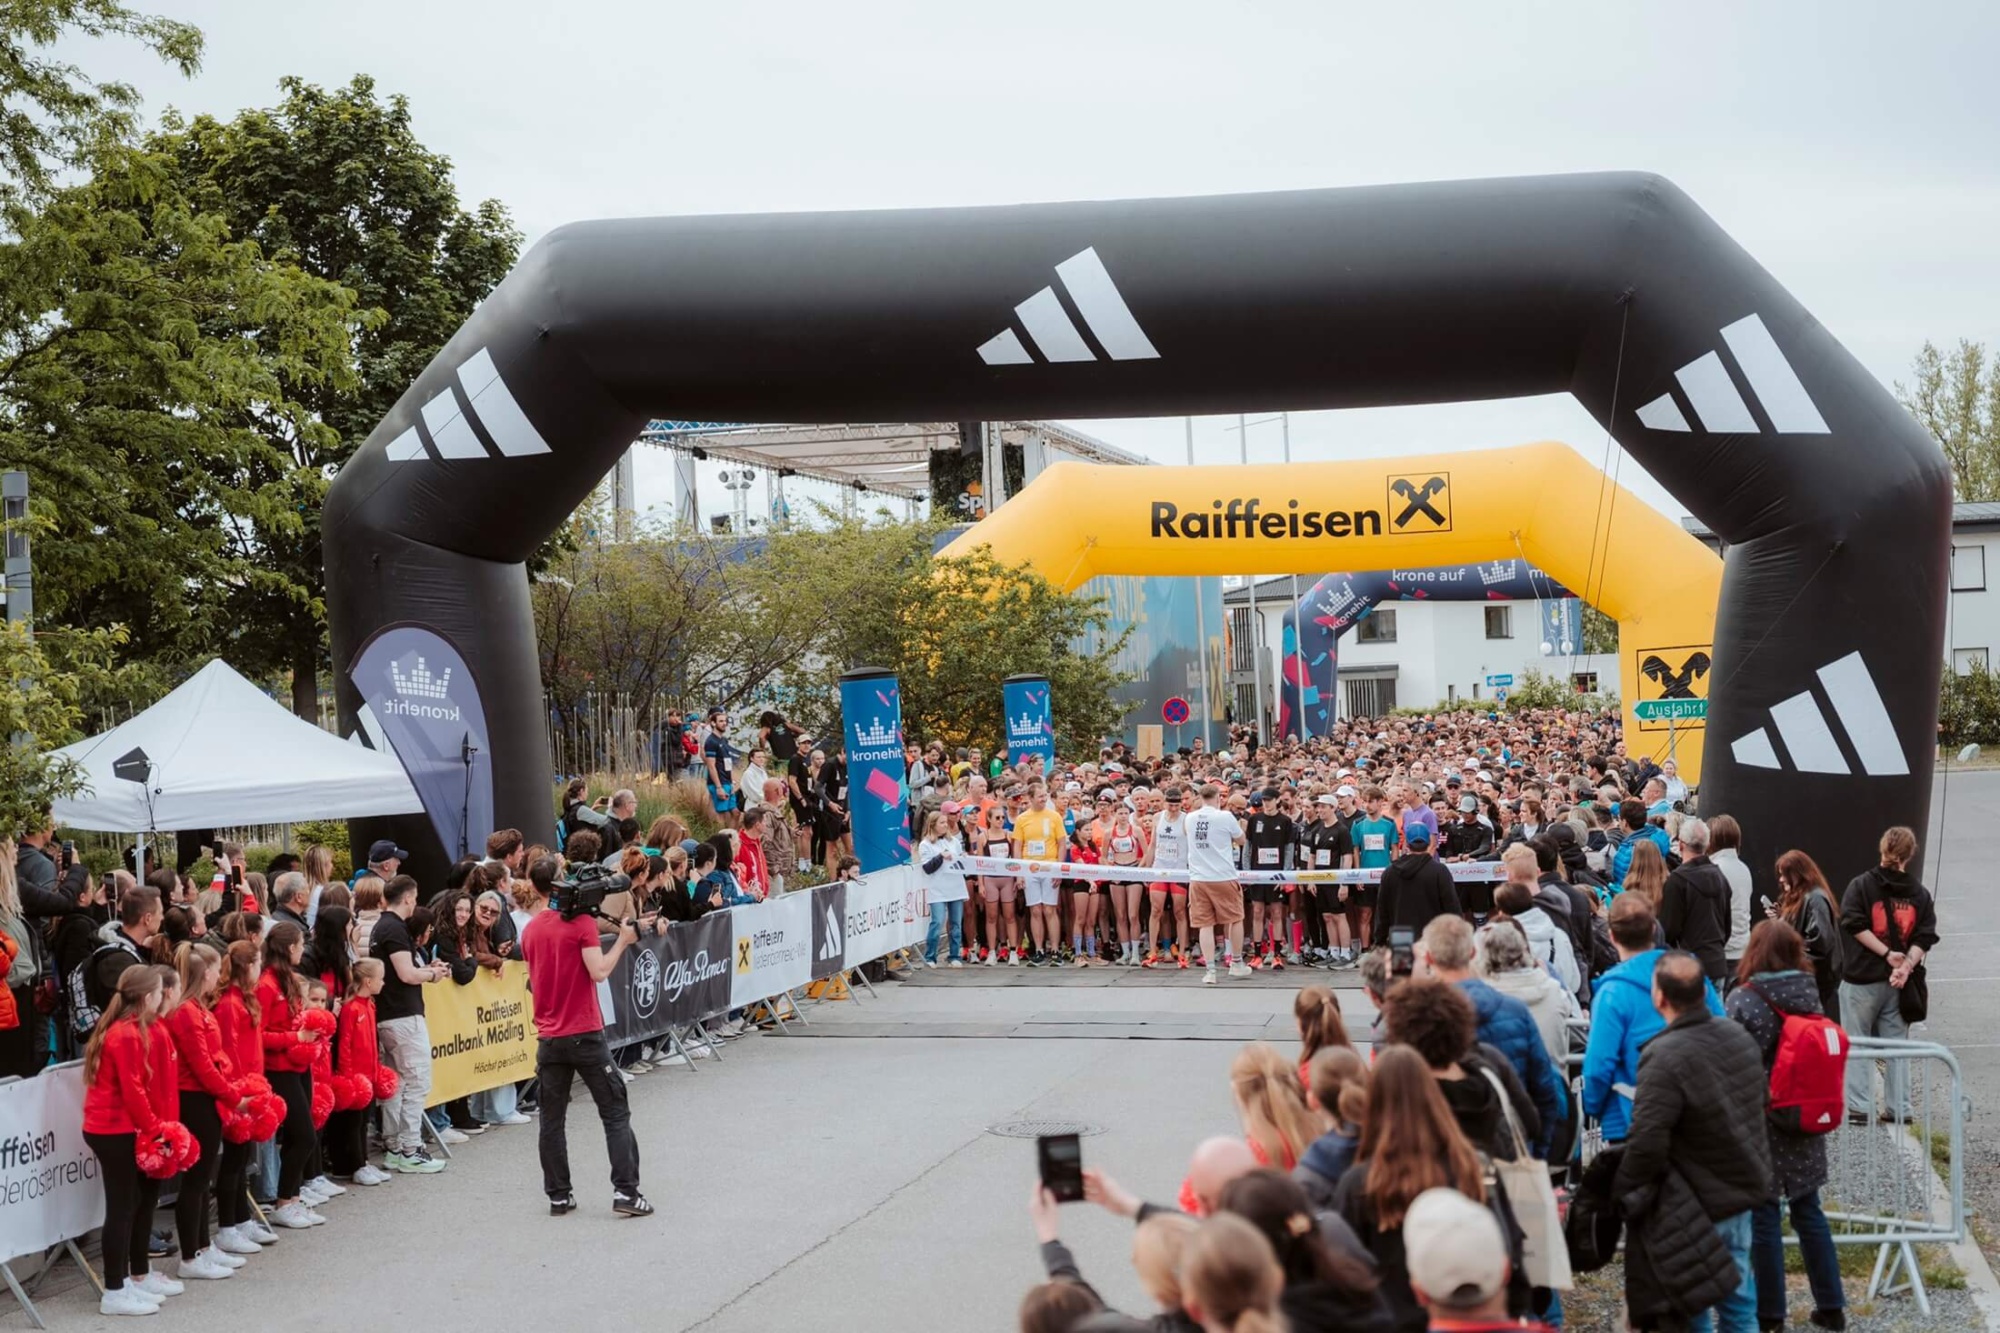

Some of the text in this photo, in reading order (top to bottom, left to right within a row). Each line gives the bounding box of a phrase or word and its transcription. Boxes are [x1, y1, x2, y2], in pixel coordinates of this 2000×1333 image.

[958, 491, 983, 514] Sp
[1151, 498, 1382, 539] Raiffeisen
[1392, 569, 1435, 582] krone
[1439, 568, 1466, 582] auf
[1328, 595, 1371, 631] kronehit
[1647, 703, 1704, 717] Ausfahrt
[852, 747, 902, 762] kronehit
[1008, 736, 1048, 749] kronehit
[1196, 821, 1209, 831] SCS
[664, 949, 728, 1003] Alfa Romeo
[476, 999, 522, 1025] Raiffeisen
[431, 1020, 525, 1060] onalbank Mödling
[0, 1130, 55, 1170] ffeisen
